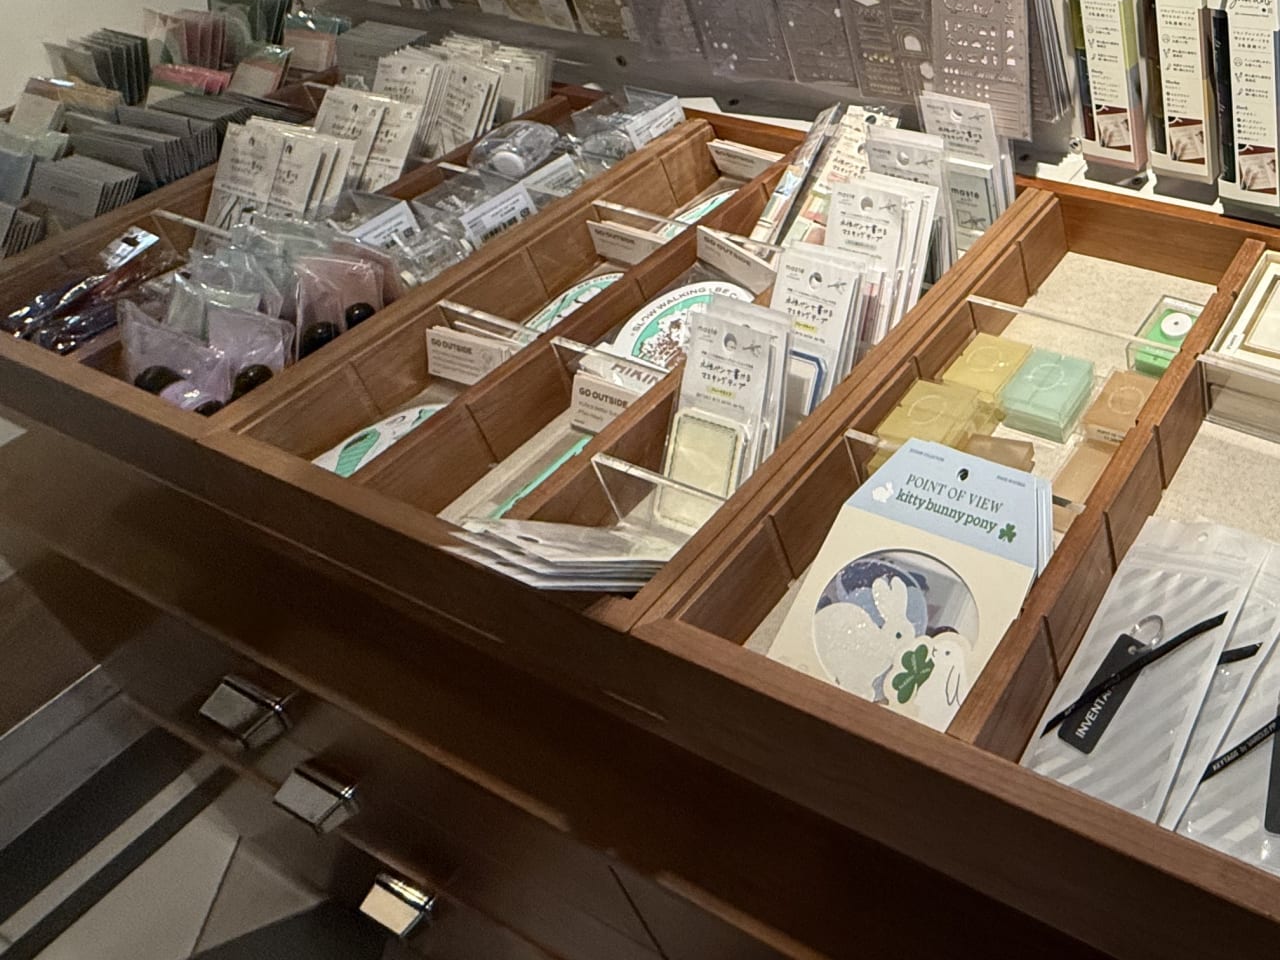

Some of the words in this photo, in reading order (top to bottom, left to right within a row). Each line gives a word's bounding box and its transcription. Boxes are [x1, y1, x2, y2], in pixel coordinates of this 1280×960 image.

[632, 308, 658, 333] SLOW
[657, 286, 707, 311] WALKING
[431, 337, 443, 347] GO
[443, 340, 473, 355] OUTSIDE
[610, 362, 660, 387] HIKIN
[578, 387, 592, 397] GO
[591, 392, 629, 410] OUTSIDE
[905, 473, 947, 497] POINT
[947, 485, 967, 502] OF
[967, 493, 1004, 514] VIEW
[895, 487, 998, 535] kittybunnypony
